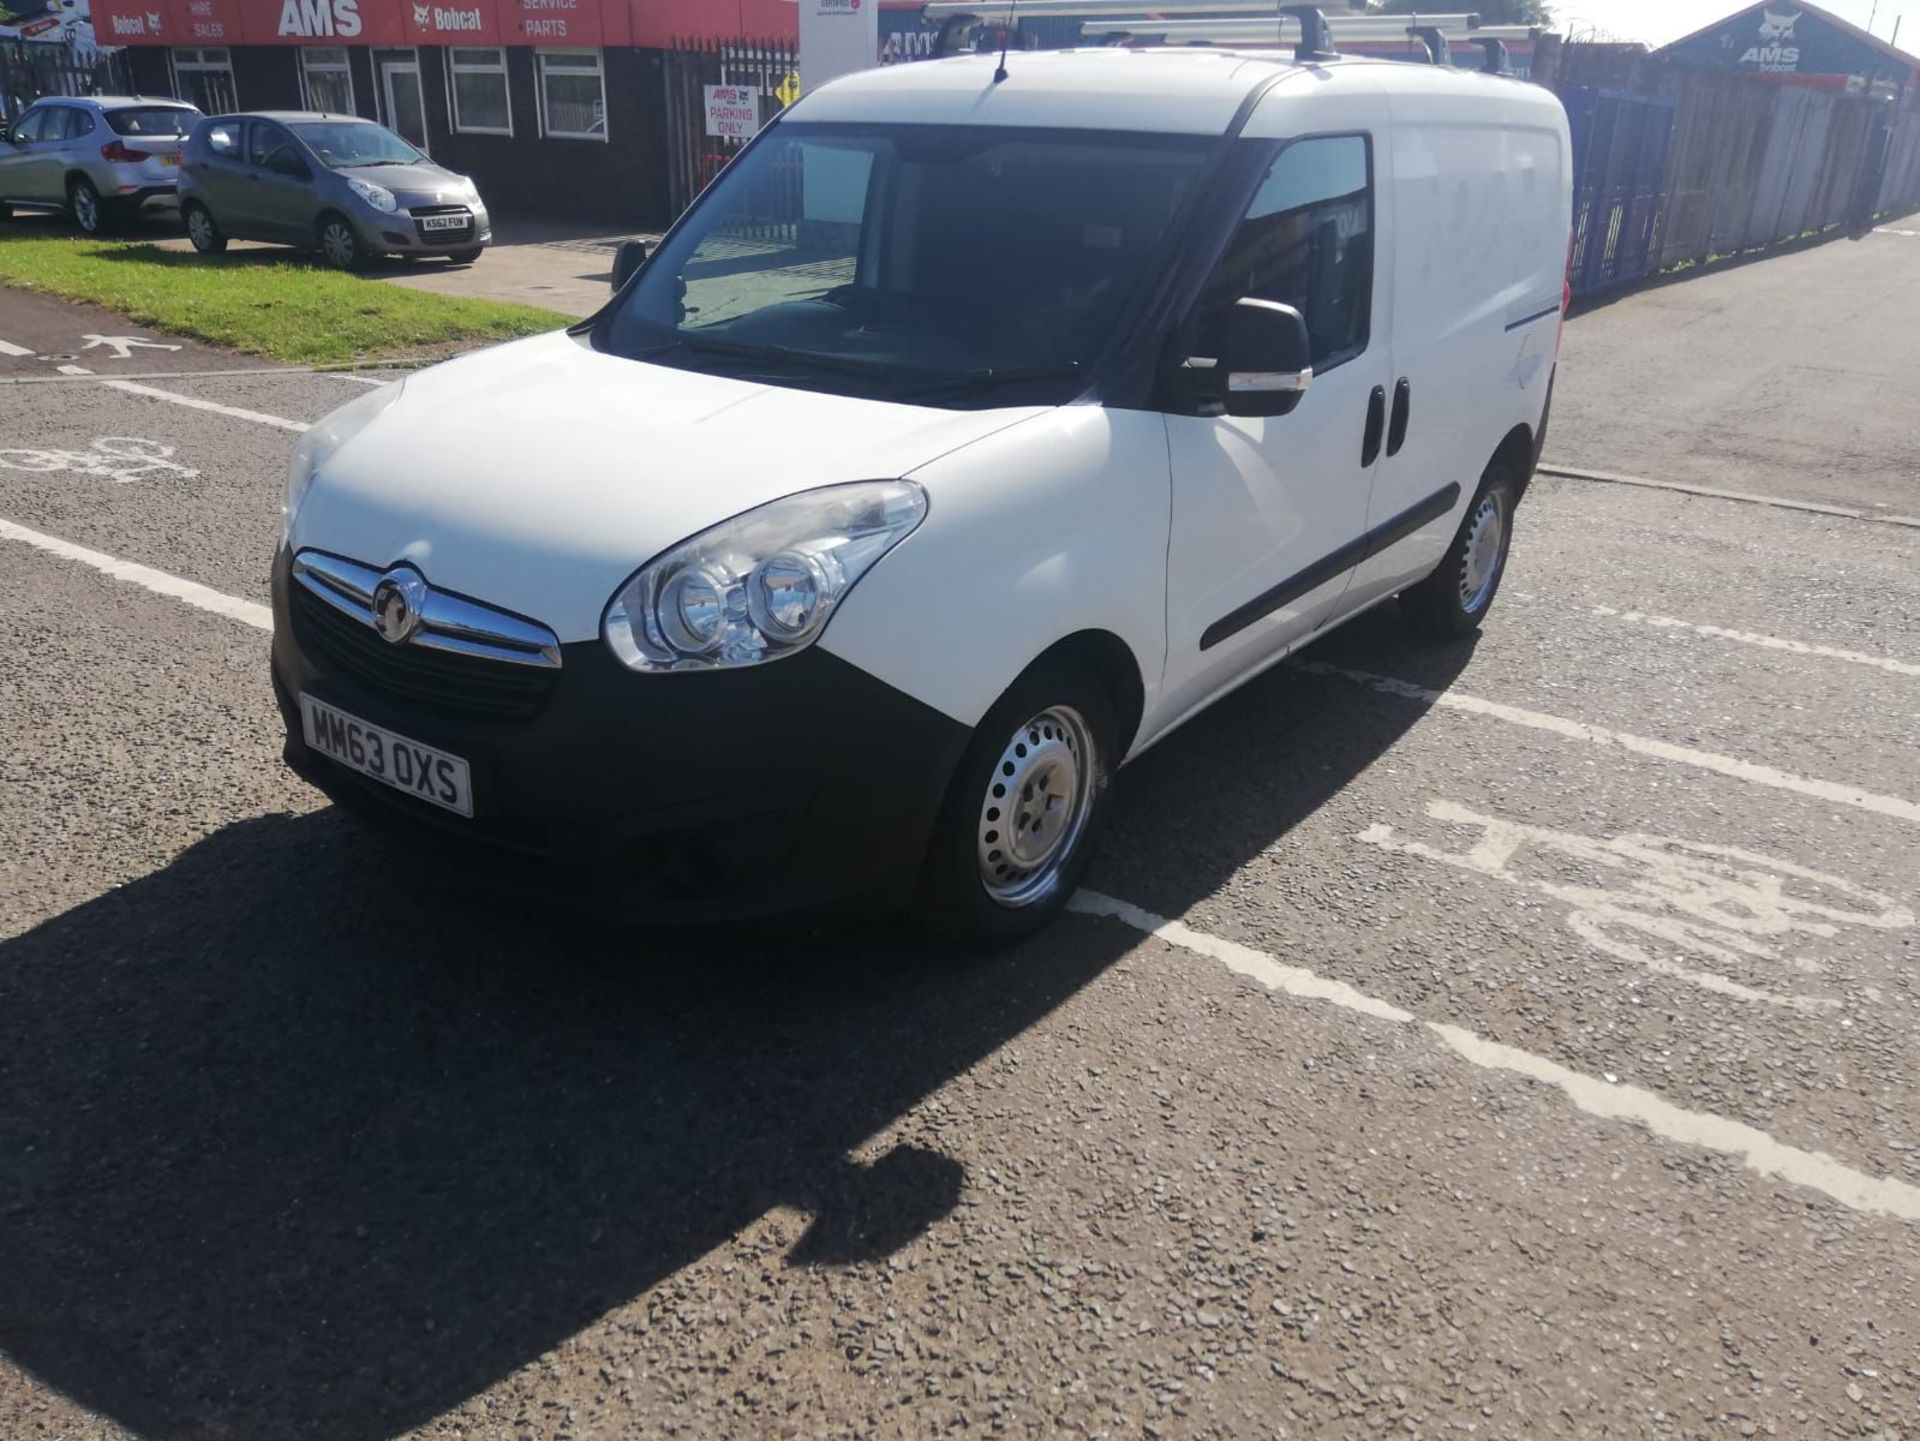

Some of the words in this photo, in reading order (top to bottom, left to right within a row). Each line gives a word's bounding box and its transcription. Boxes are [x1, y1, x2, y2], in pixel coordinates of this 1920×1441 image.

[112, 15, 145, 35] Bobcat
[277, 0, 363, 37] AMS
[434, 7, 482, 31] Bobcat
[193, 23, 224, 38] SALES
[525, 20, 567, 37] PARTS
[1739, 47, 1800, 63] AMS
[713, 88, 737, 101] AMS
[710, 107, 753, 121] PARKING
[718, 121, 743, 135] ONLY
[426, 218, 447, 229] KS62
[312, 705, 385, 774] MM63
[393, 742, 458, 804] OXS
